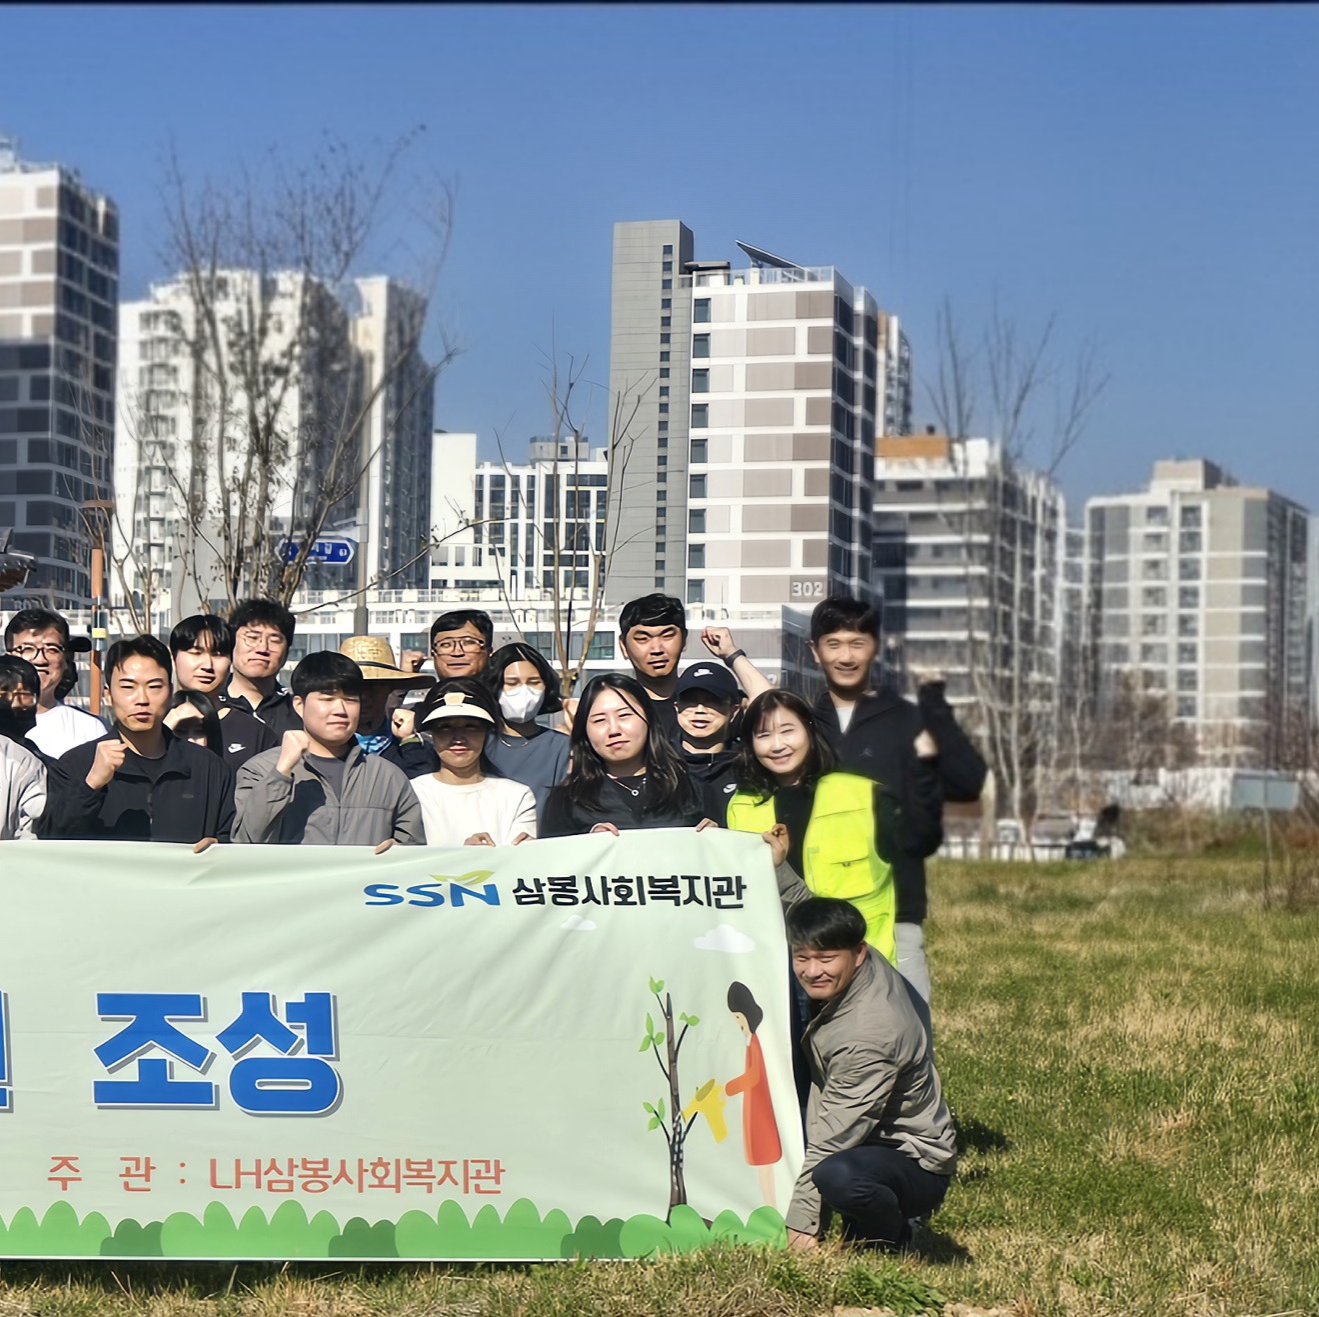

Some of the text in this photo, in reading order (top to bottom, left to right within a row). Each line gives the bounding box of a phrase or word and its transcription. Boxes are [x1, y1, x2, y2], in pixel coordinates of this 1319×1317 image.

[791, 581, 823, 596] 302
[363, 882, 501, 907] SSN
[512, 874, 747, 910] 삼봉사회복지관
[91, 990, 343, 1115] 조성
[47, 1156, 82, 1191] 주
[119, 1156, 156, 1192] 관
[209, 1157, 507, 1194] LH삼봉사회복지관
